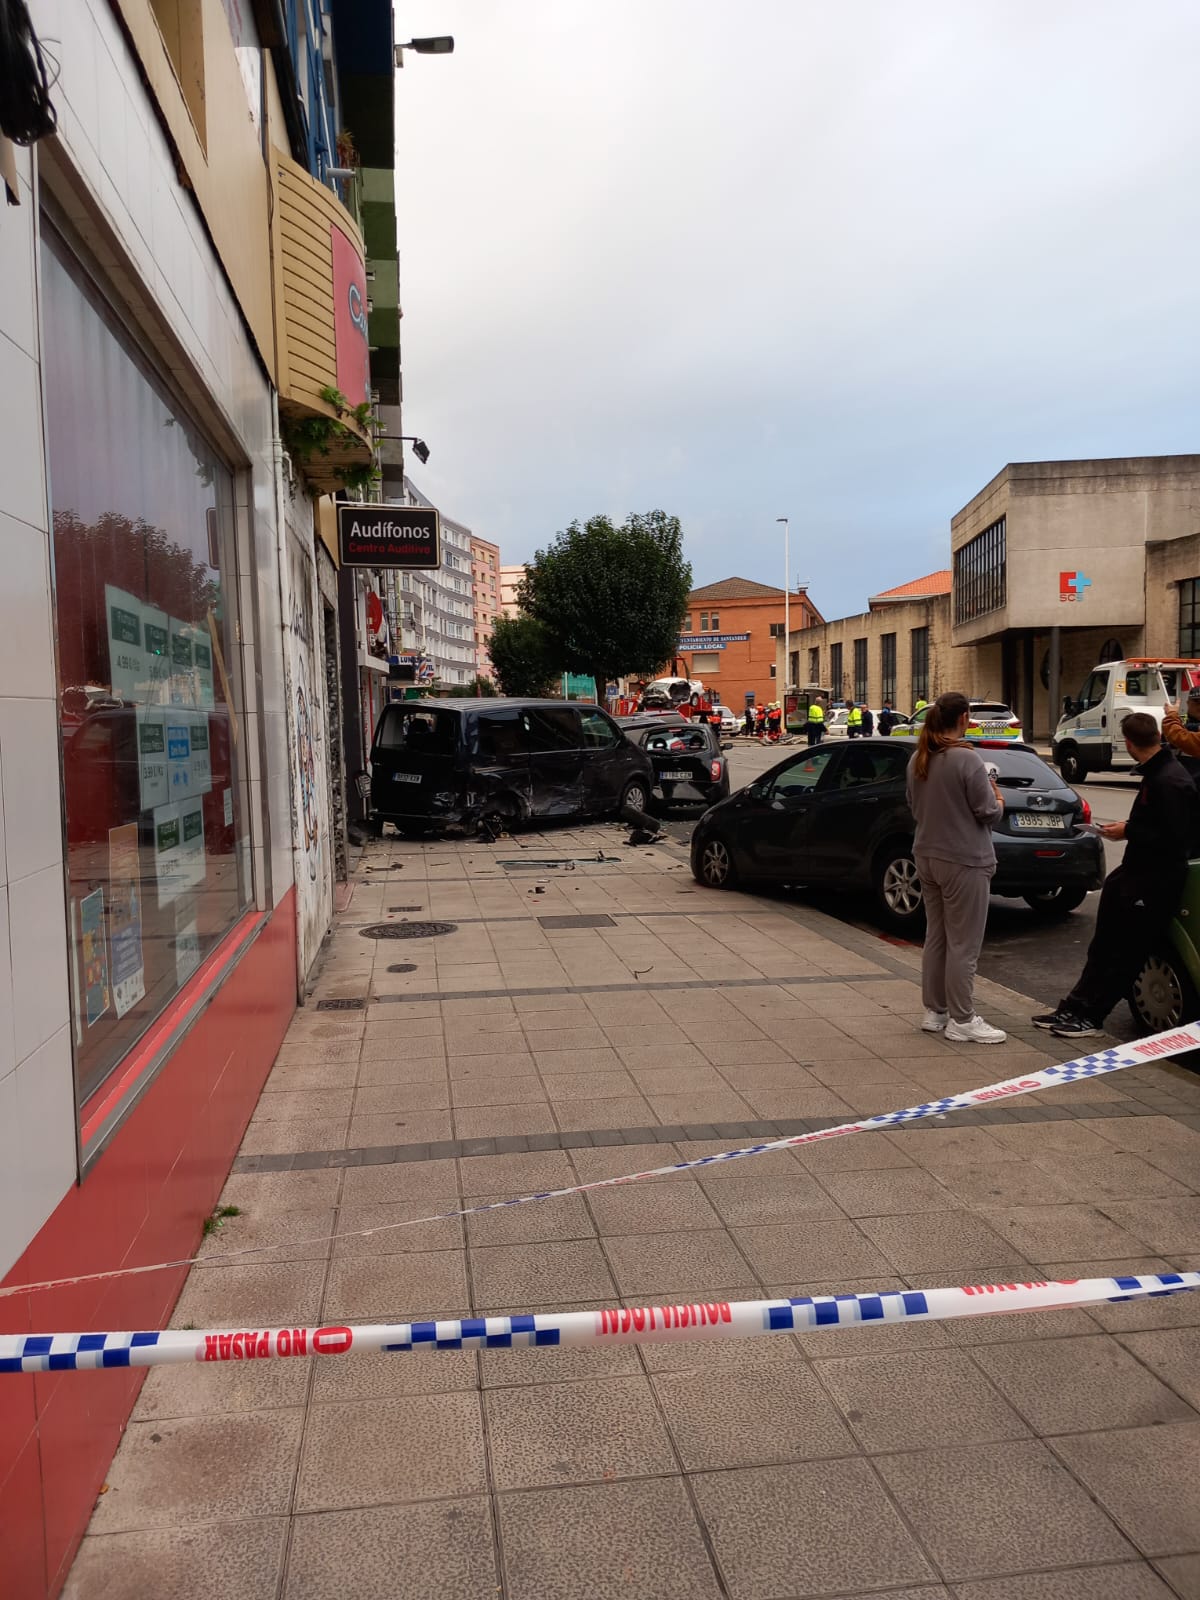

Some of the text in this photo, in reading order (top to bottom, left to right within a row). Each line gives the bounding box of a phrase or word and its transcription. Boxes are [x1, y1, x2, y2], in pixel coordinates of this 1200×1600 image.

[350, 521, 430, 539] Audífonos
[348, 542, 431, 554] Centro Auditivo
[1059, 594, 1084, 602] SCS
[1020, 815, 1061, 826] 3985 JBP
[204, 1328, 307, 1361] NO PASAR
